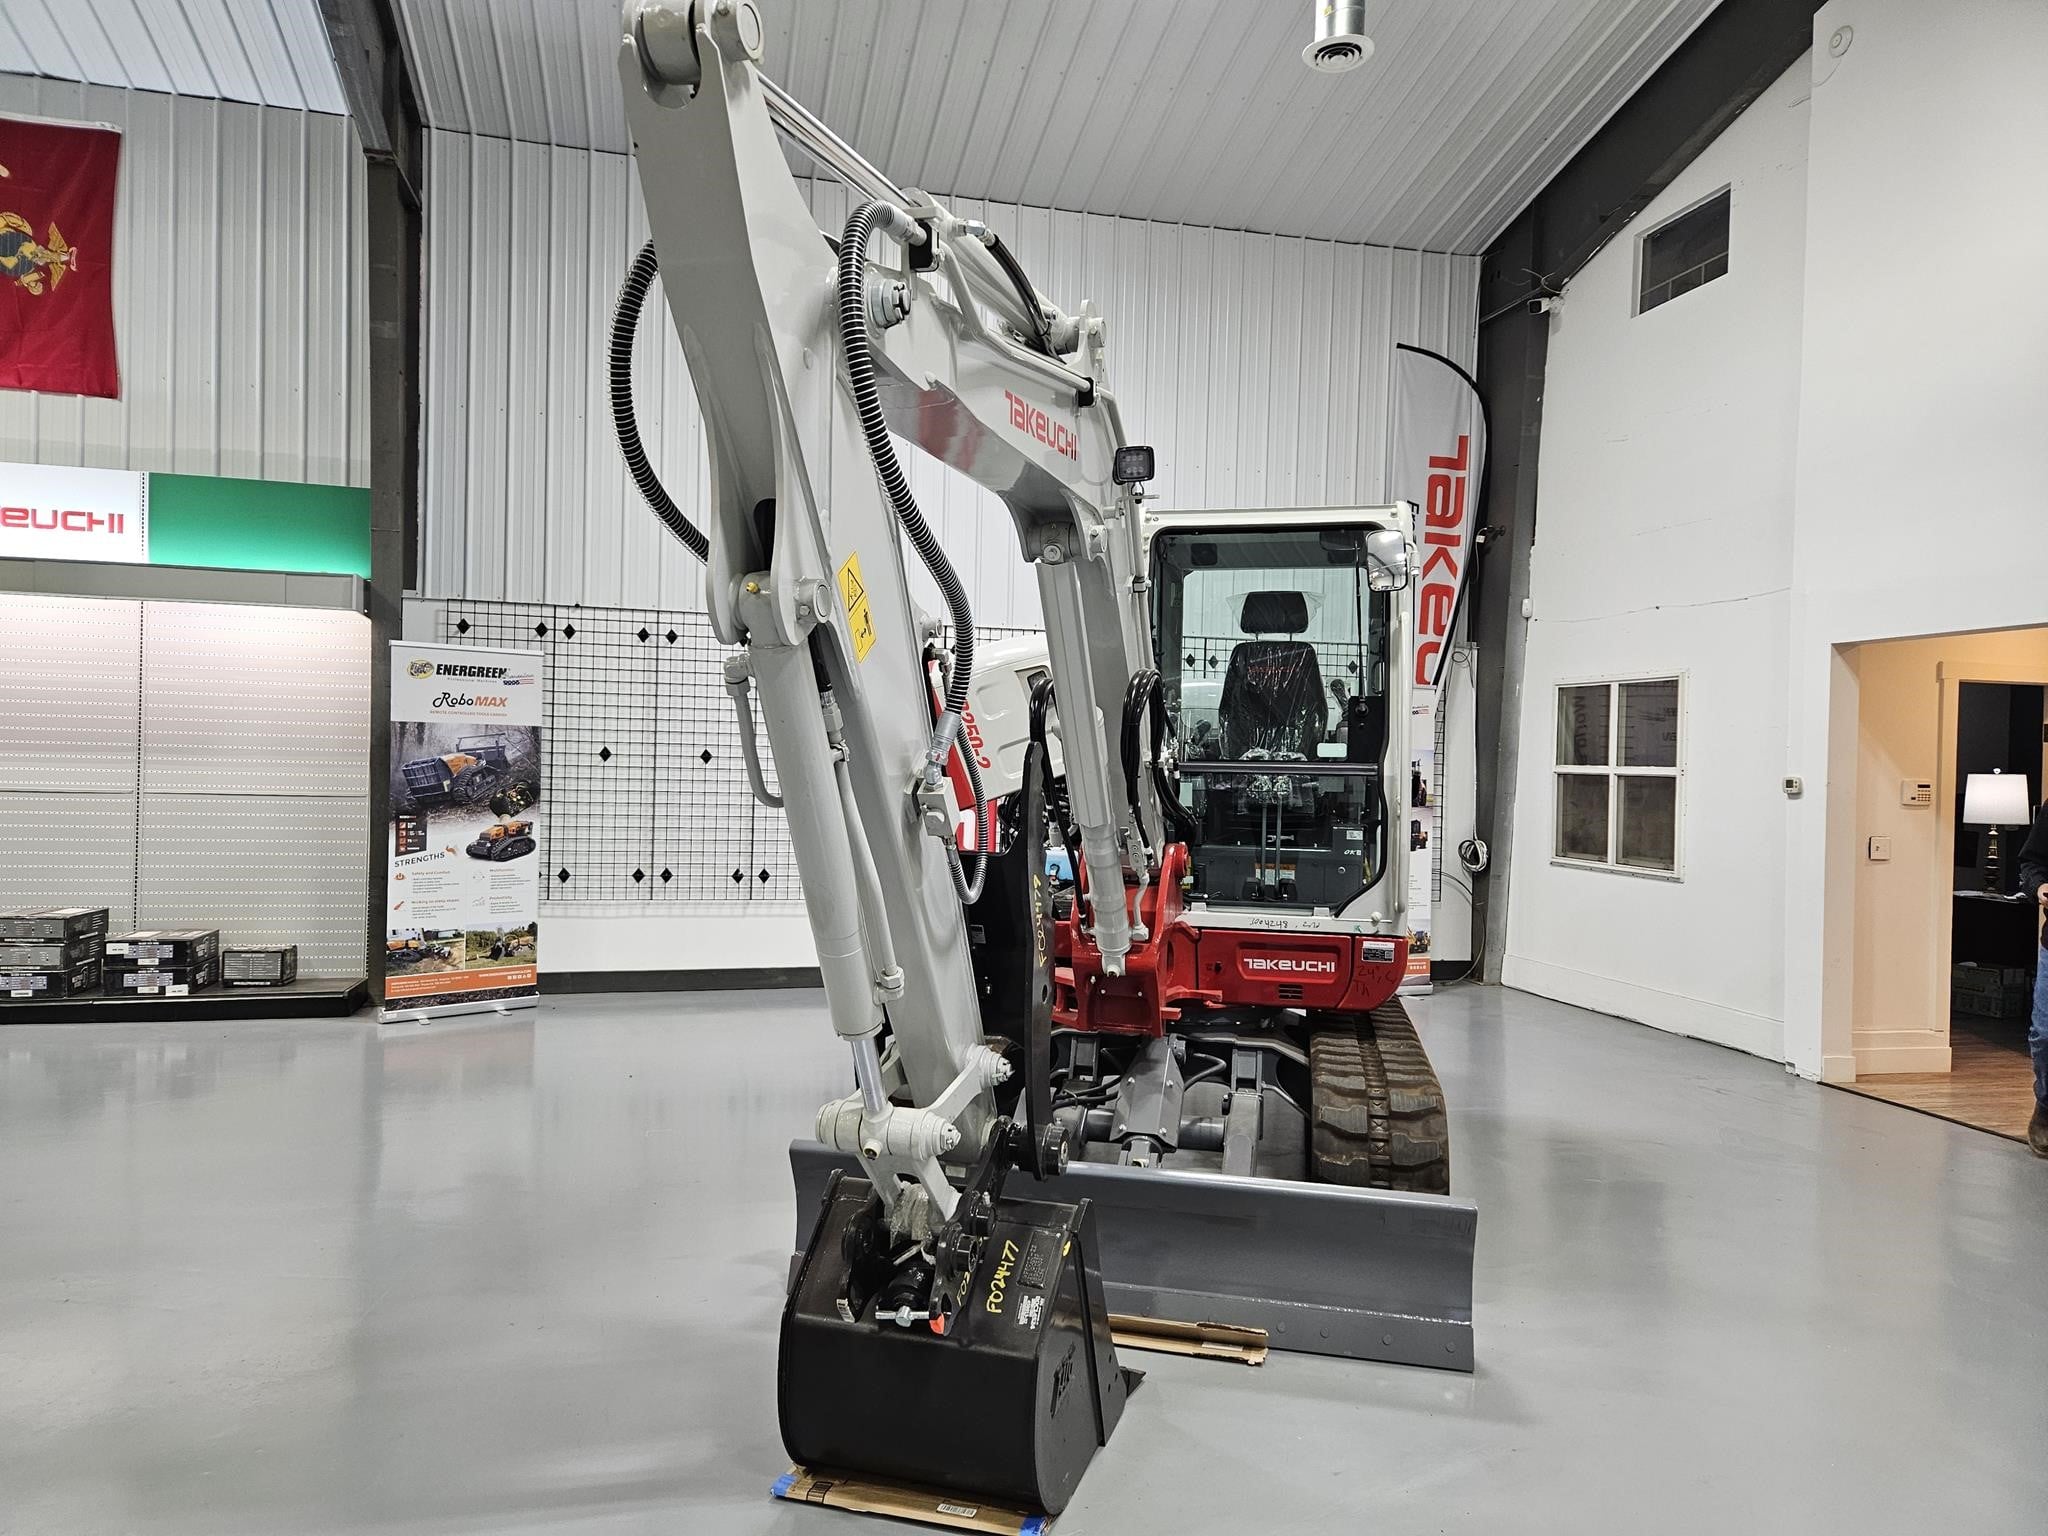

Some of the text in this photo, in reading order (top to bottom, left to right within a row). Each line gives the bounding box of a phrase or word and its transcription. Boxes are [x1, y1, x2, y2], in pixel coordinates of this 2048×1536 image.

[1005, 389, 1077, 461] TAKEUCHI
[394, 851, 445, 868] STRENGTHS
[1243, 958, 1335, 973] TAKEUCHI
